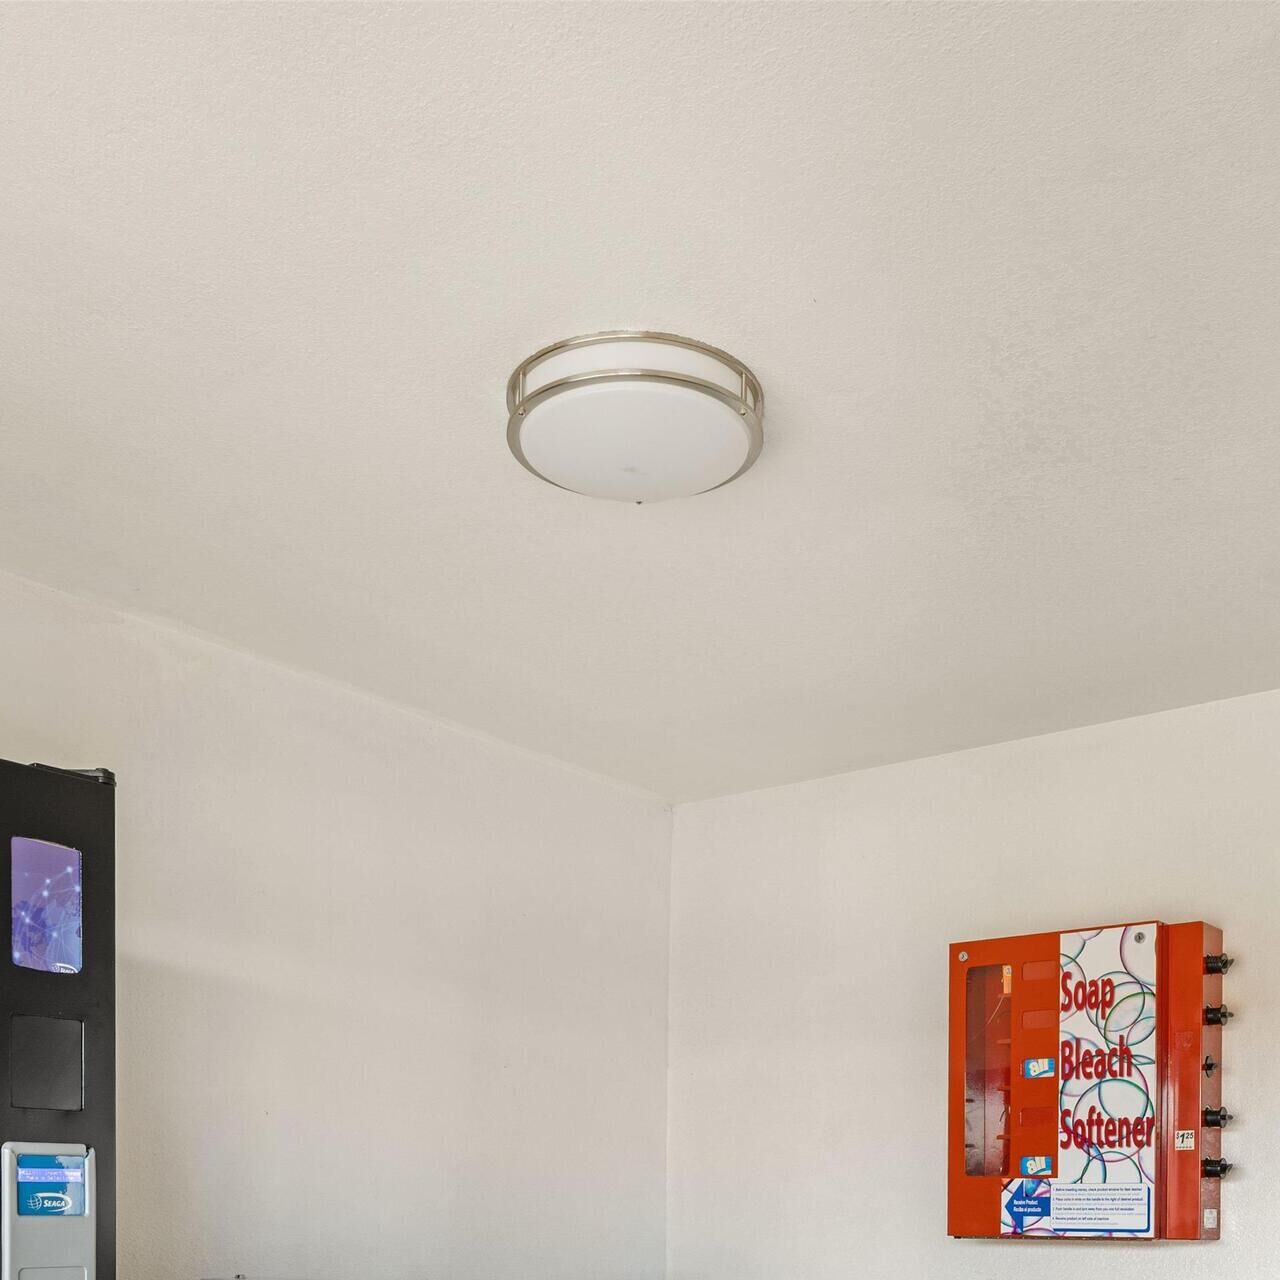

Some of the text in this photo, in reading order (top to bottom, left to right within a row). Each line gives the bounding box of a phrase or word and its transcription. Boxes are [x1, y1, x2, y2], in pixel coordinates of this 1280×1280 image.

[1060, 971, 1115, 1020] Soap
[1060, 1034, 1133, 1080] Bleach
[1060, 1105, 1155, 1150] Softener
[43, 1199, 66, 1208] SEAGA
